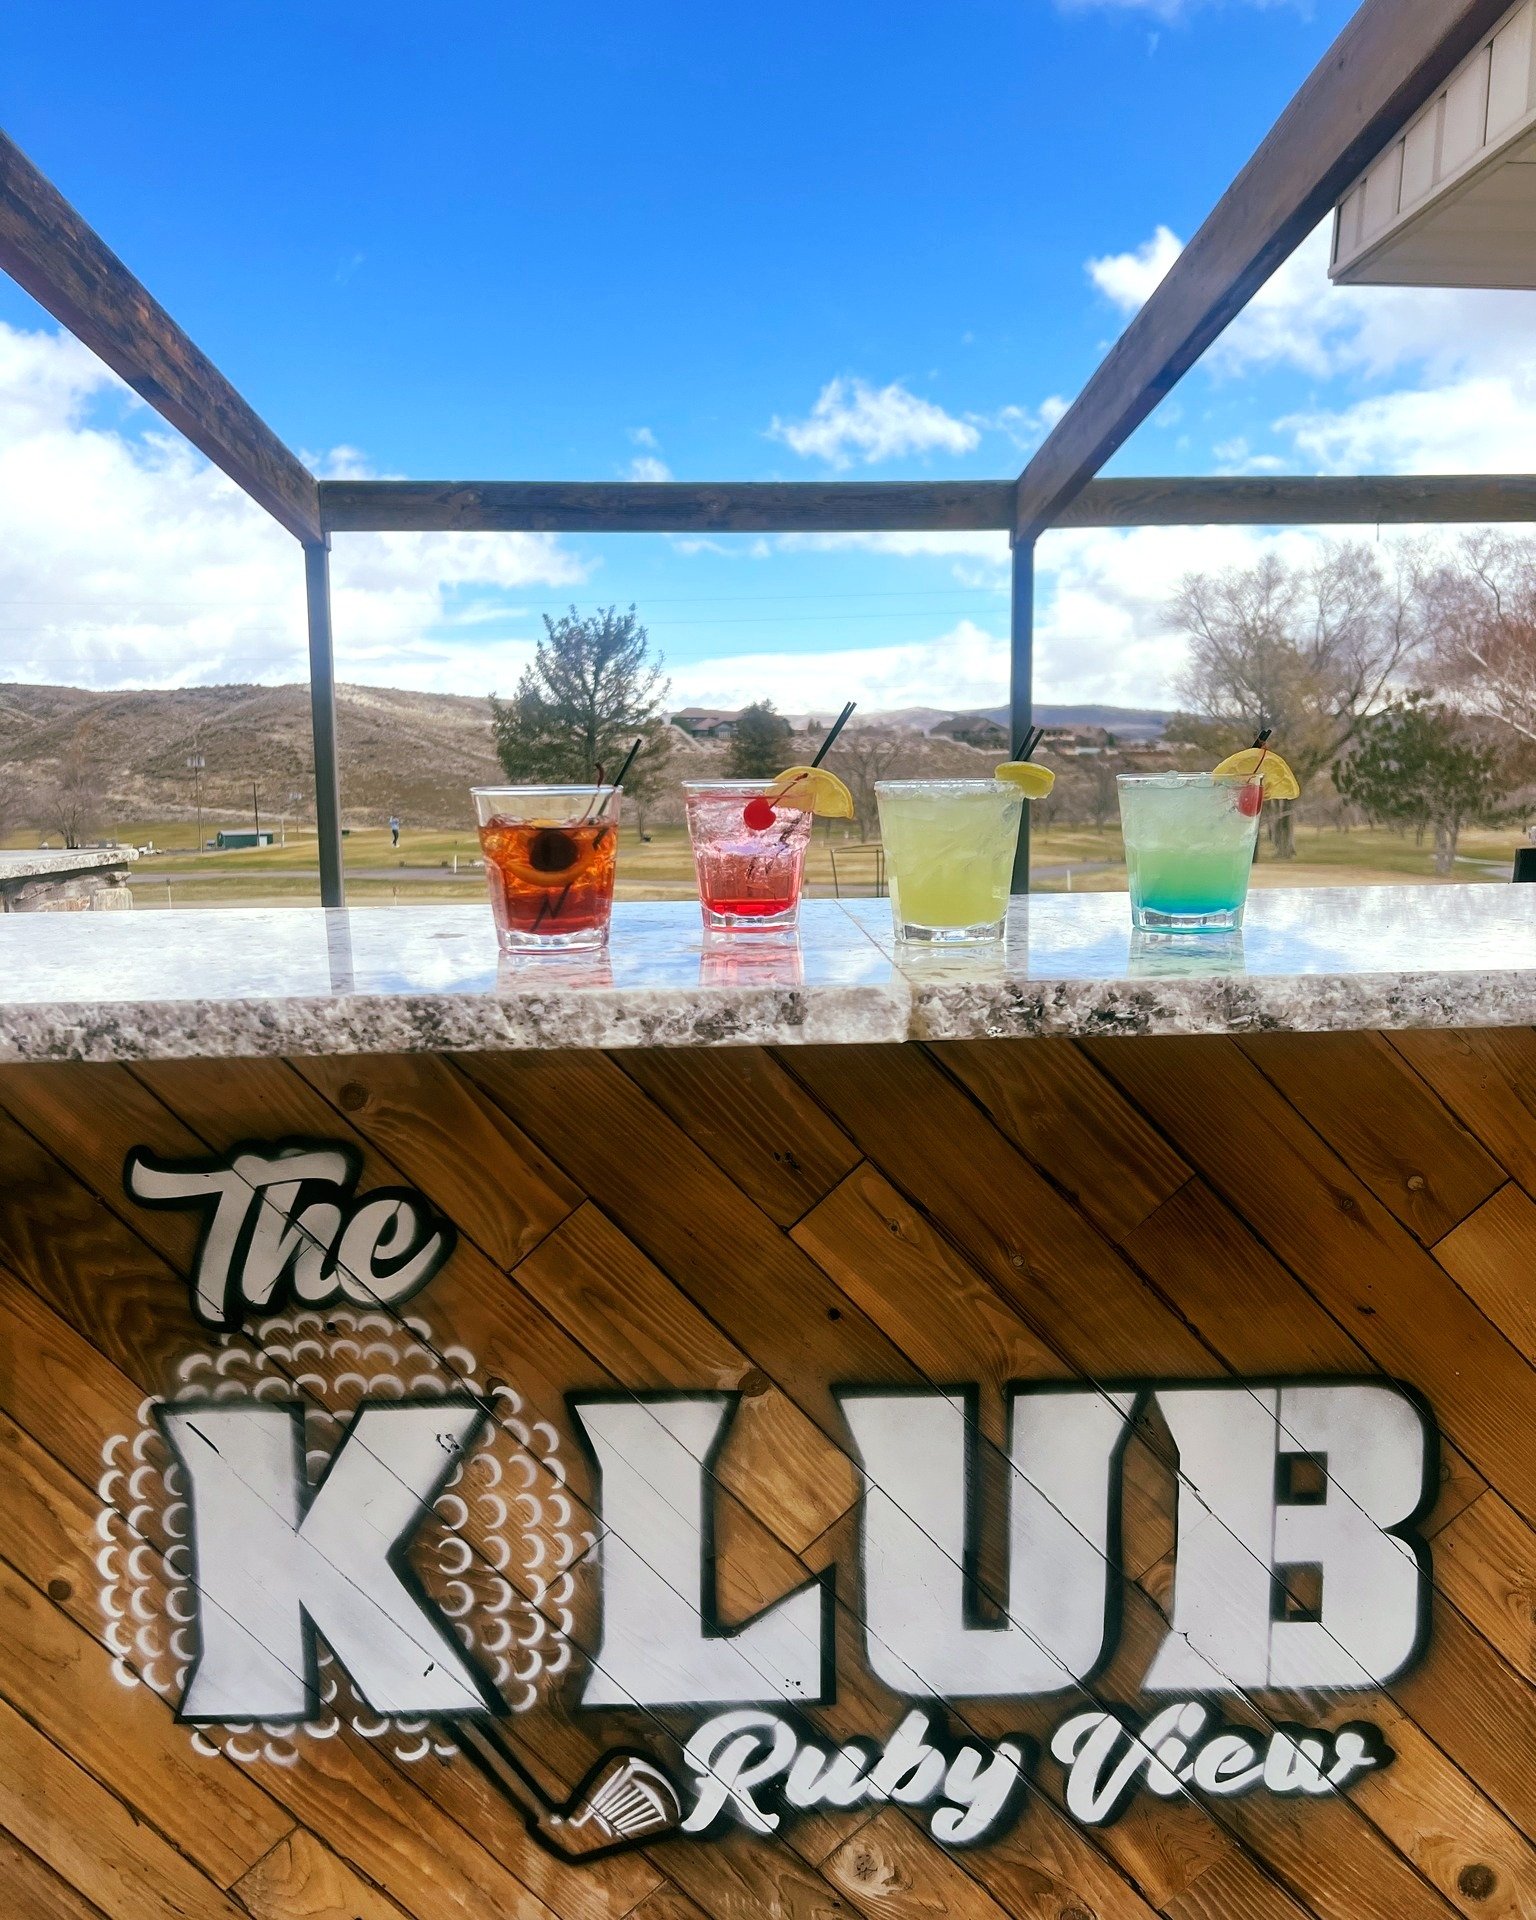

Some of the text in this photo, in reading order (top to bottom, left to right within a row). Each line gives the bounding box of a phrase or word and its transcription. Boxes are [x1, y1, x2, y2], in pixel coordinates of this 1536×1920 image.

[130, 1148, 443, 1323] The
[162, 1387, 1428, 1718] KLUB
[680, 1702, 1376, 1843] Ruby View
